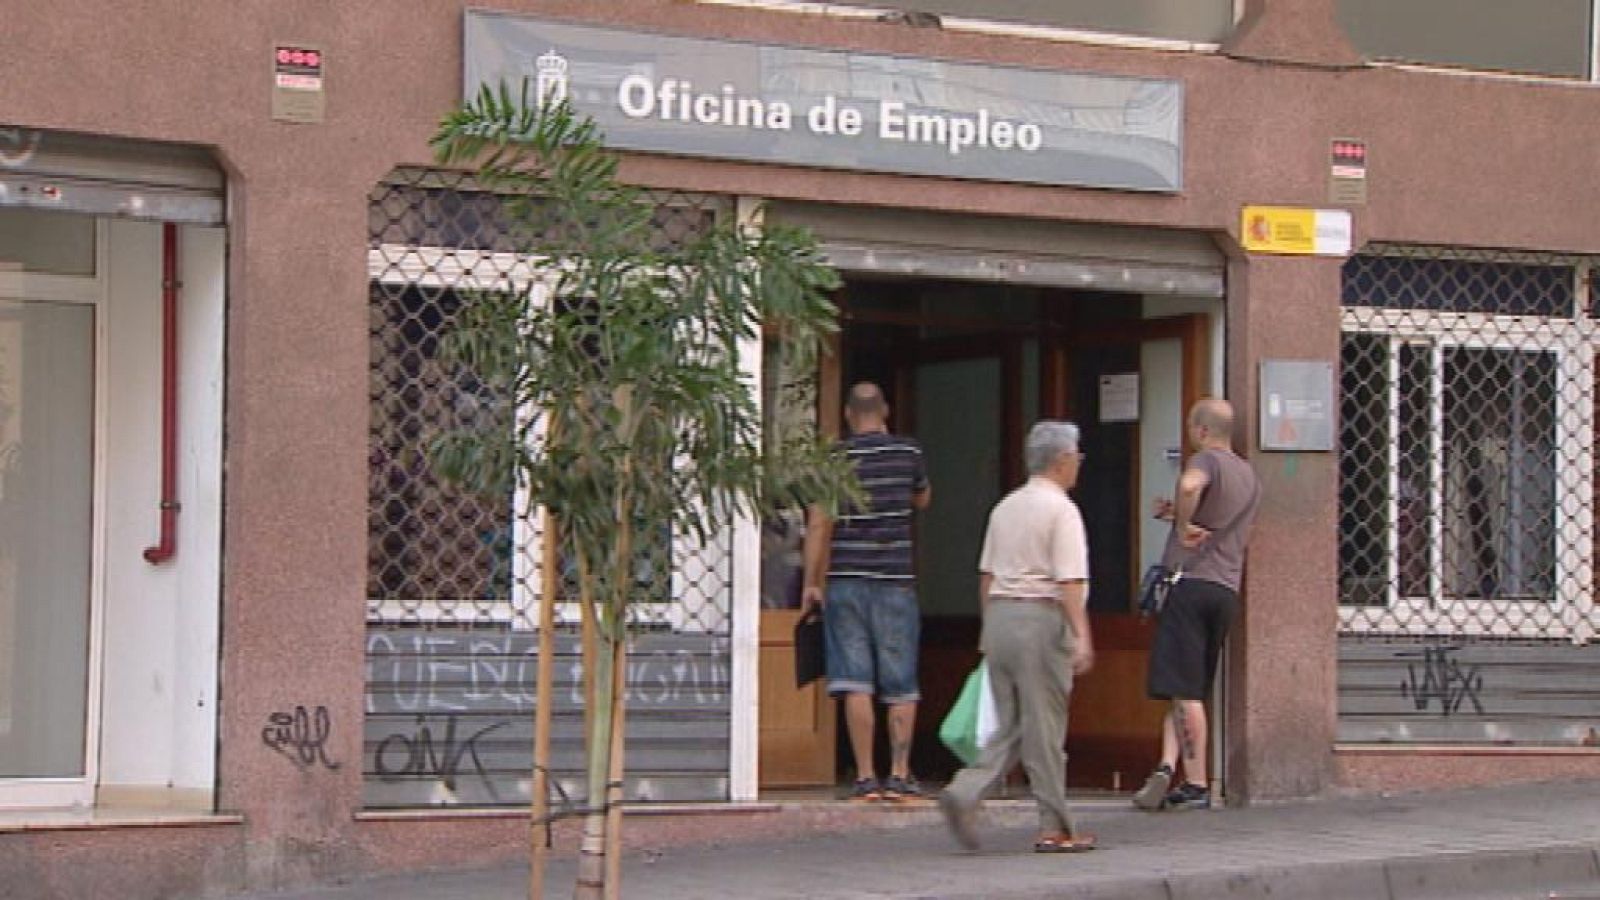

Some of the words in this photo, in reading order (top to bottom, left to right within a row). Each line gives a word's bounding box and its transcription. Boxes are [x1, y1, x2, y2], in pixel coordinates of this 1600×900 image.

[618, 74, 791, 130] Oficina
[808, 96, 862, 136] de
[879, 102, 1042, 154] Empleo
